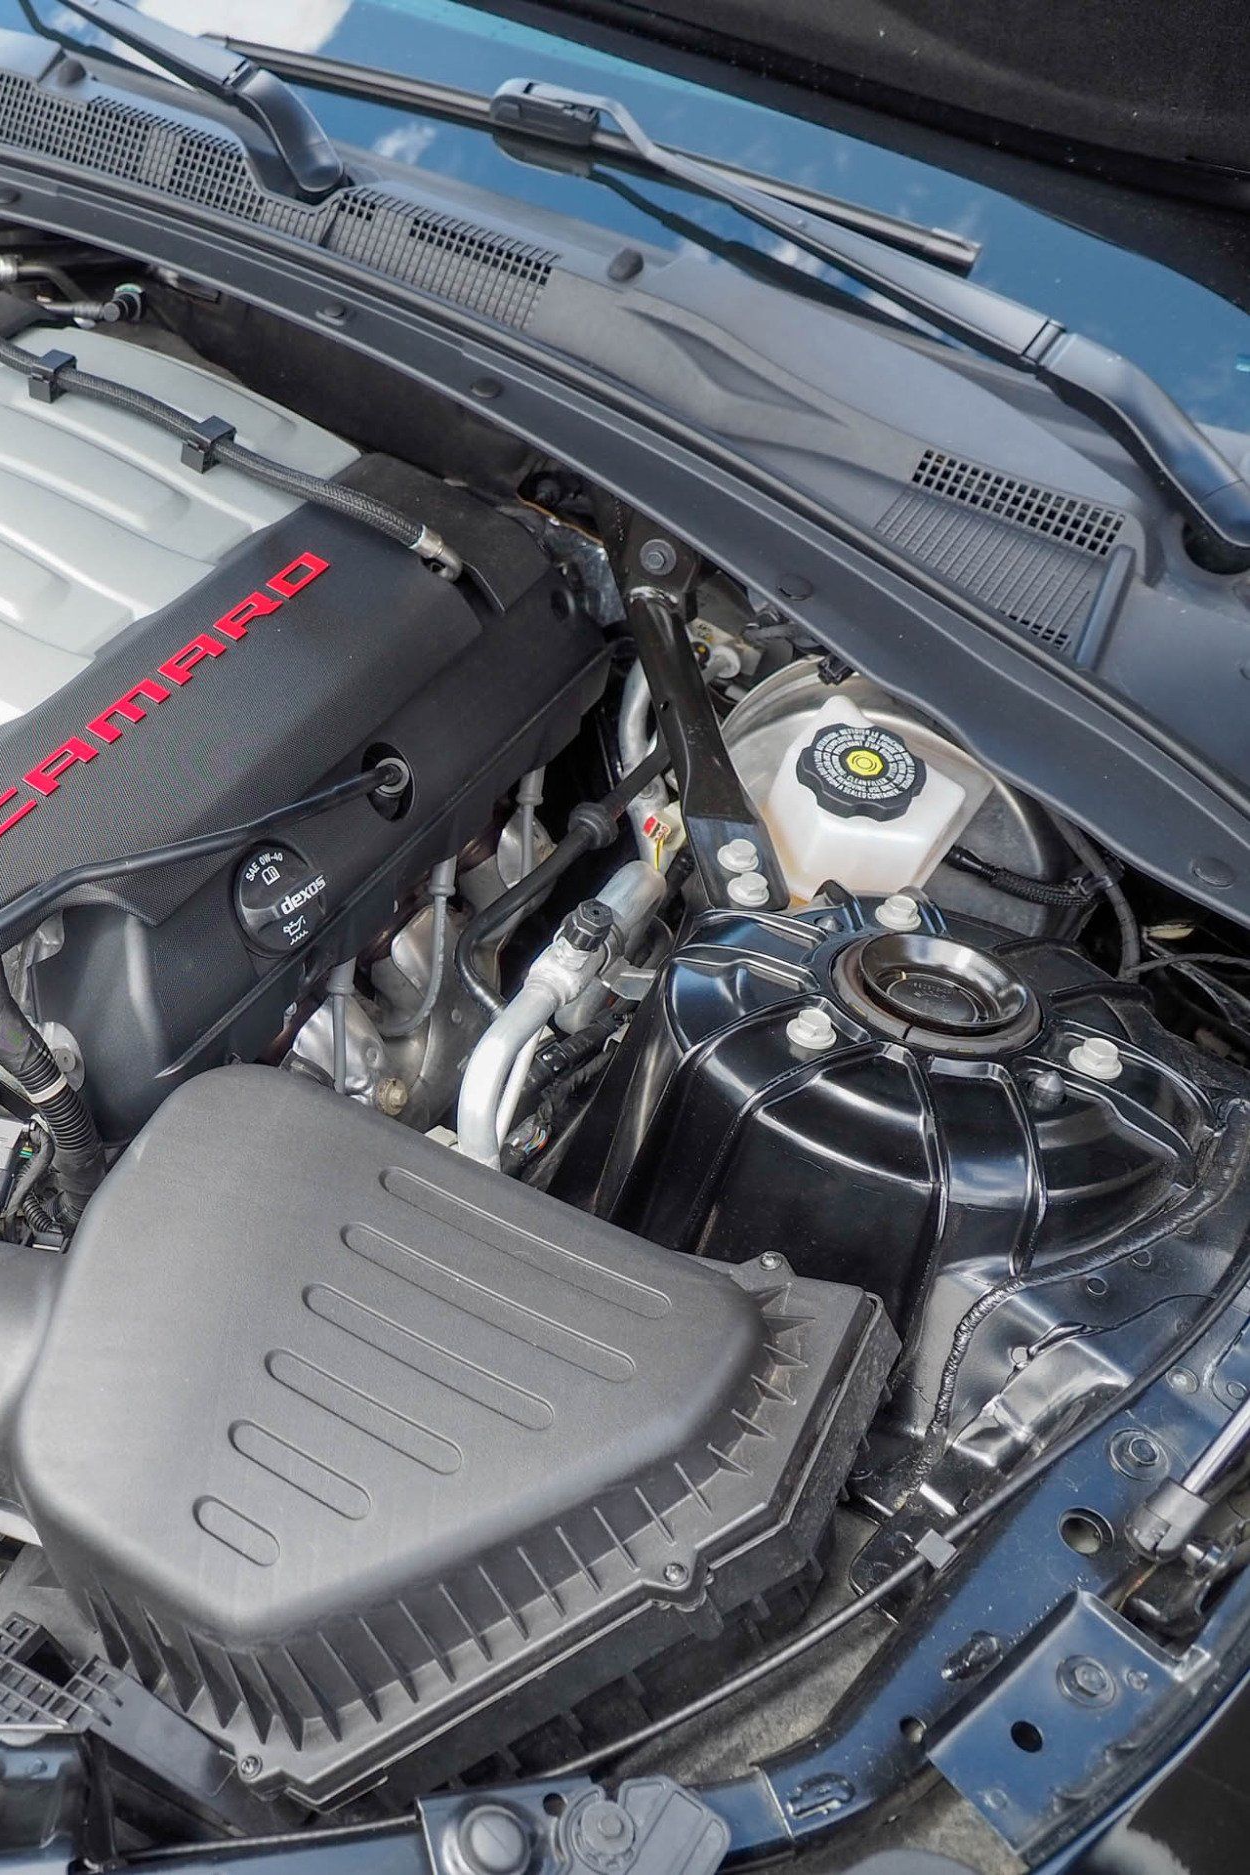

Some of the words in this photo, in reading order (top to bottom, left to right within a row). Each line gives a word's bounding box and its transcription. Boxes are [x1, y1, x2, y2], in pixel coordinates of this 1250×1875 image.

[245, 862, 260, 881] SAE
[258, 852, 283, 866] 0W-40
[281, 874, 327, 915] dexos
